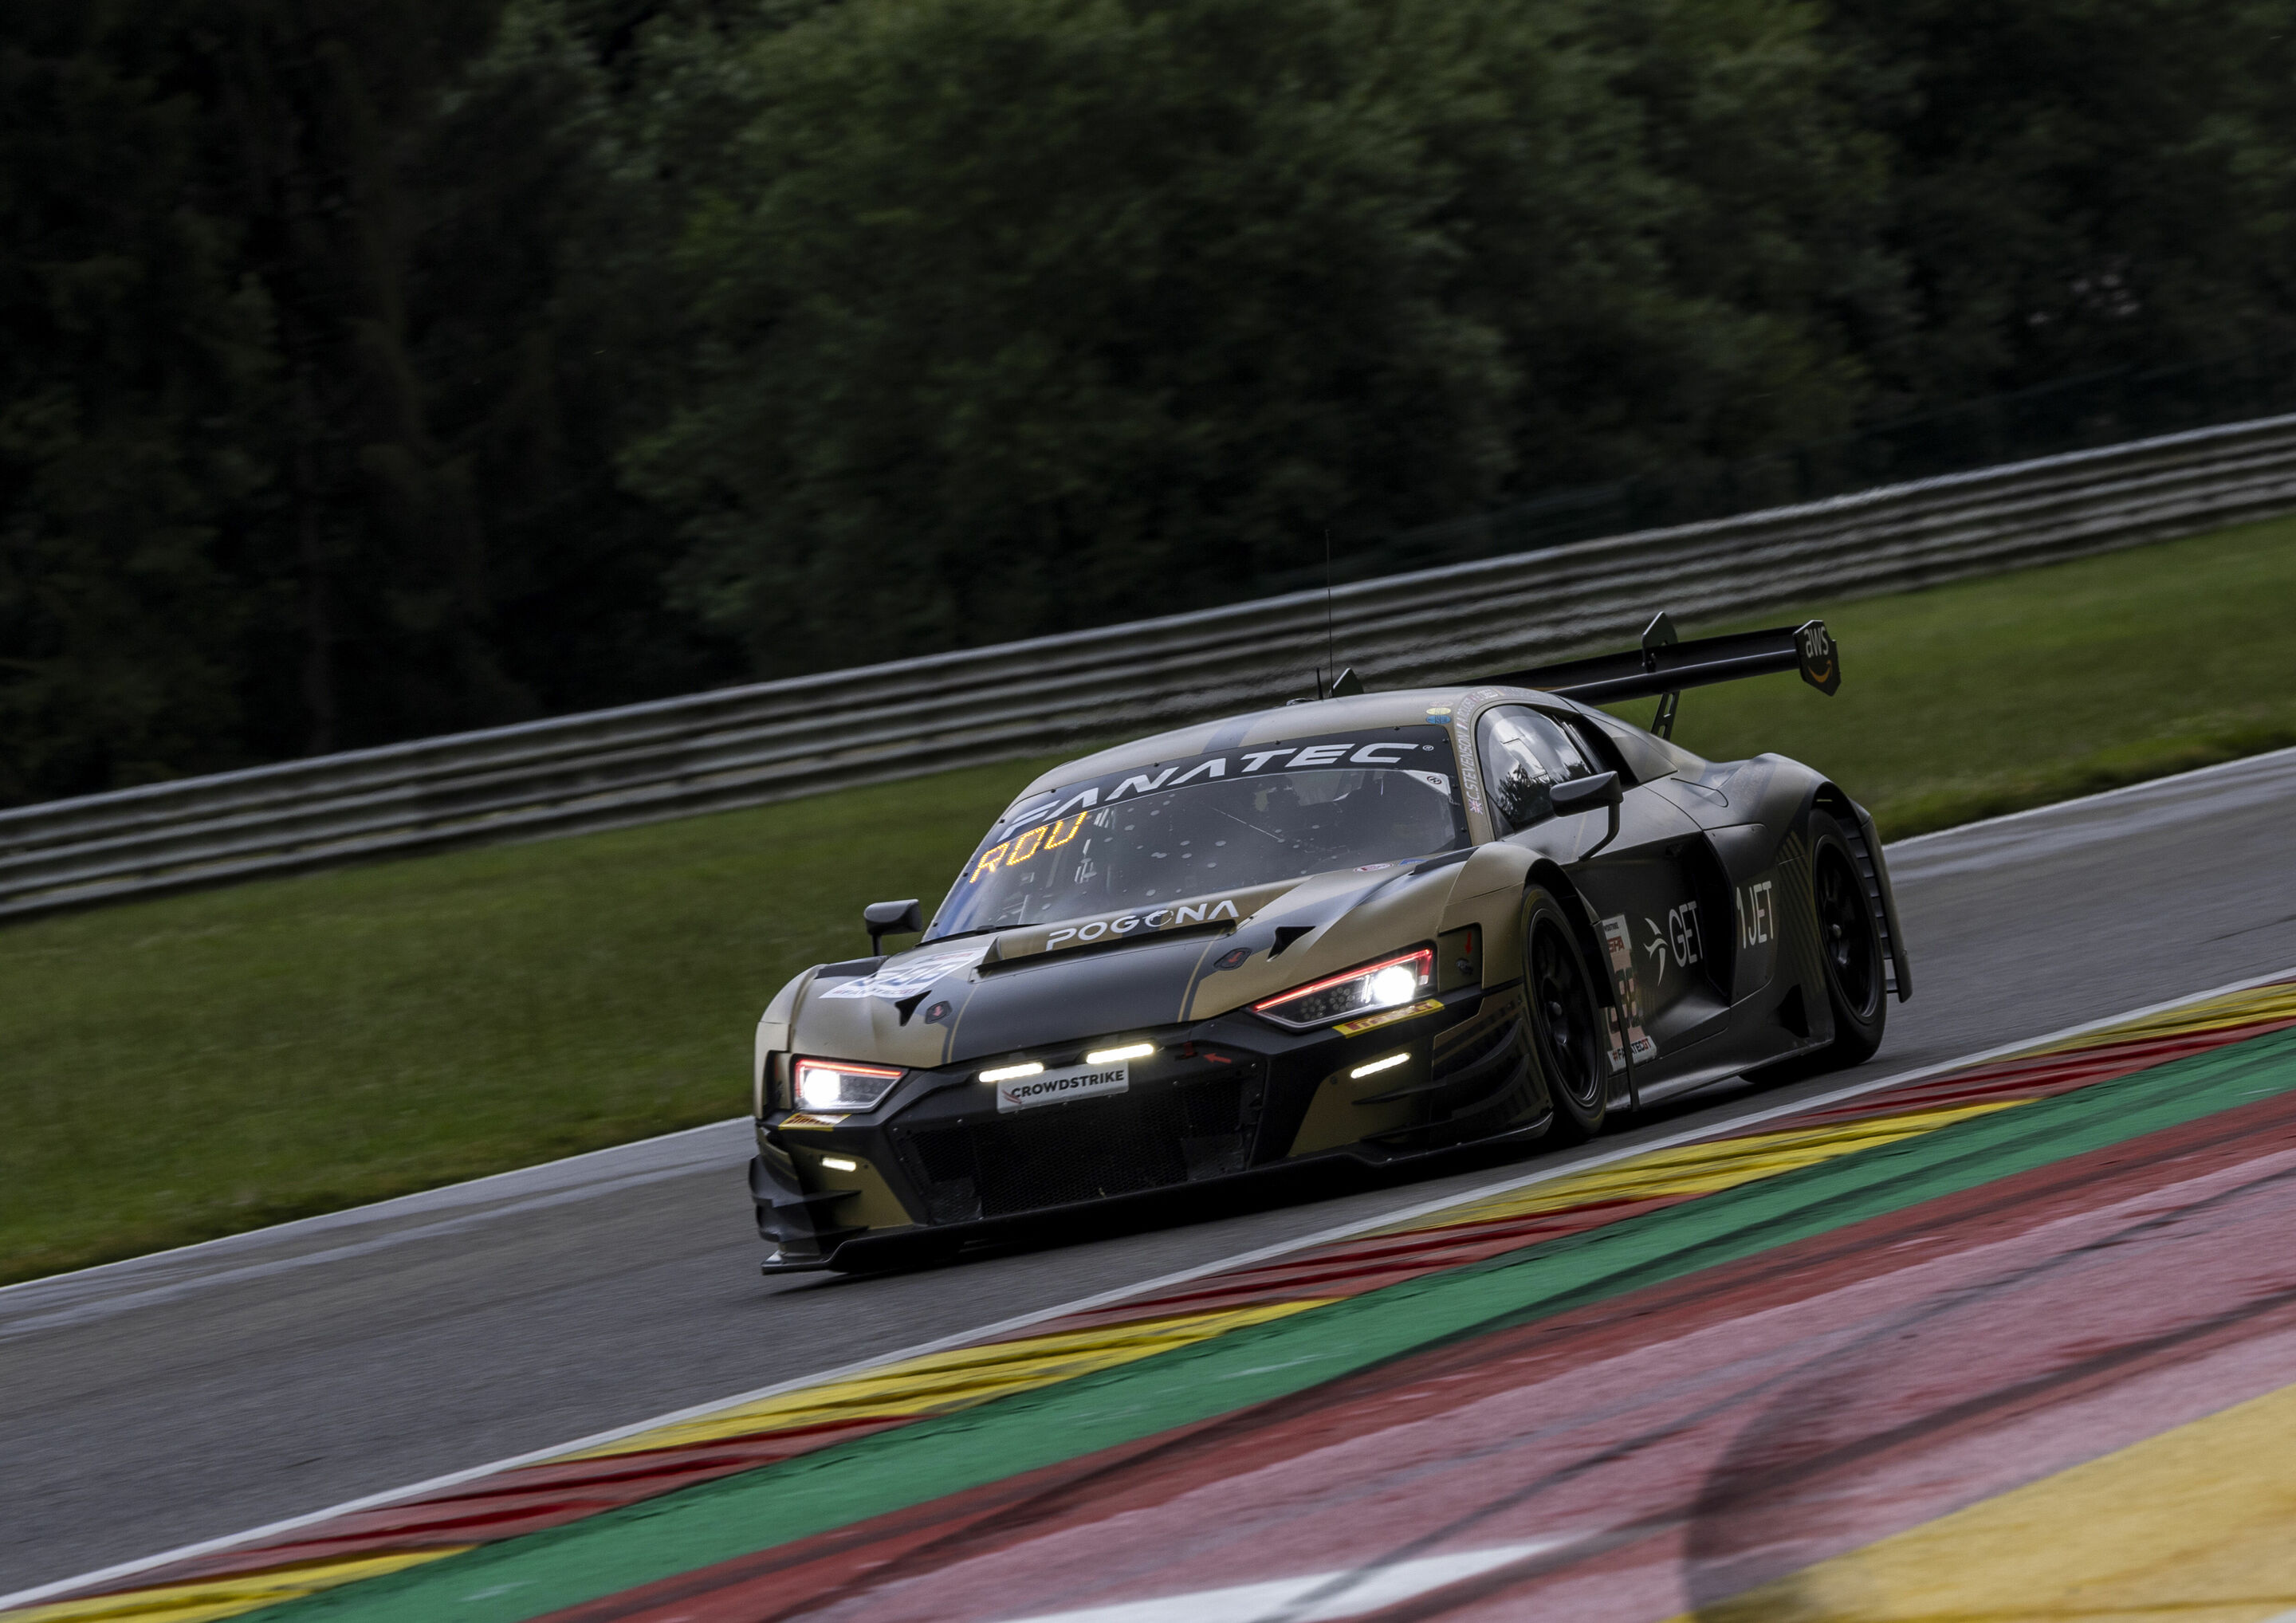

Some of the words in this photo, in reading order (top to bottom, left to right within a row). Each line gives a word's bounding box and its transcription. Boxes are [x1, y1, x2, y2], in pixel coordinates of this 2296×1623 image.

[1804, 627, 1829, 658] aws
[997, 743, 1419, 844] FANATEC
[1456, 733, 1480, 800] C.STEVENSON
[969, 811, 1087, 883] ROU
[1045, 900, 1239, 951] POGONA
[1669, 901, 1704, 968] GET
[1612, 1038, 1652, 1062] #FAATECGT
[1010, 1070, 1125, 1098] CROWDSTRIKE
